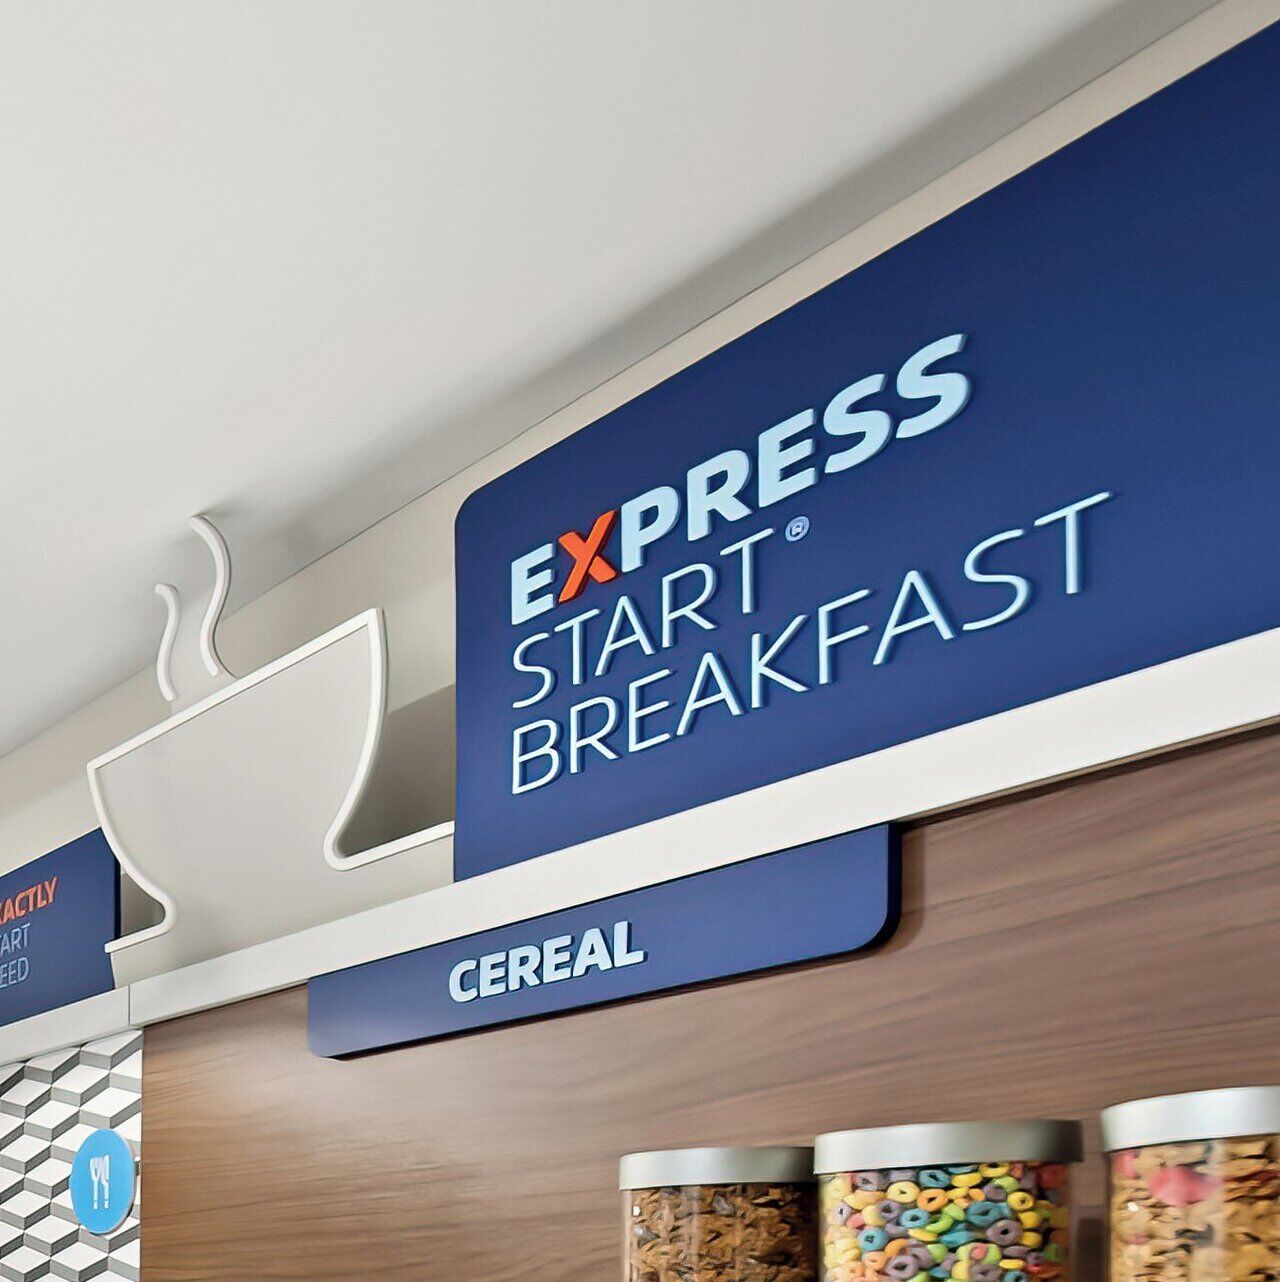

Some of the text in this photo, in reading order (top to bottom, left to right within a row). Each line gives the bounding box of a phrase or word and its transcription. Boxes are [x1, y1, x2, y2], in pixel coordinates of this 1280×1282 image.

[511, 333, 971, 625] EXPRESS
[511, 490, 1113, 795] BREAKFAST
[449, 920, 646, 1003] CEREAL
